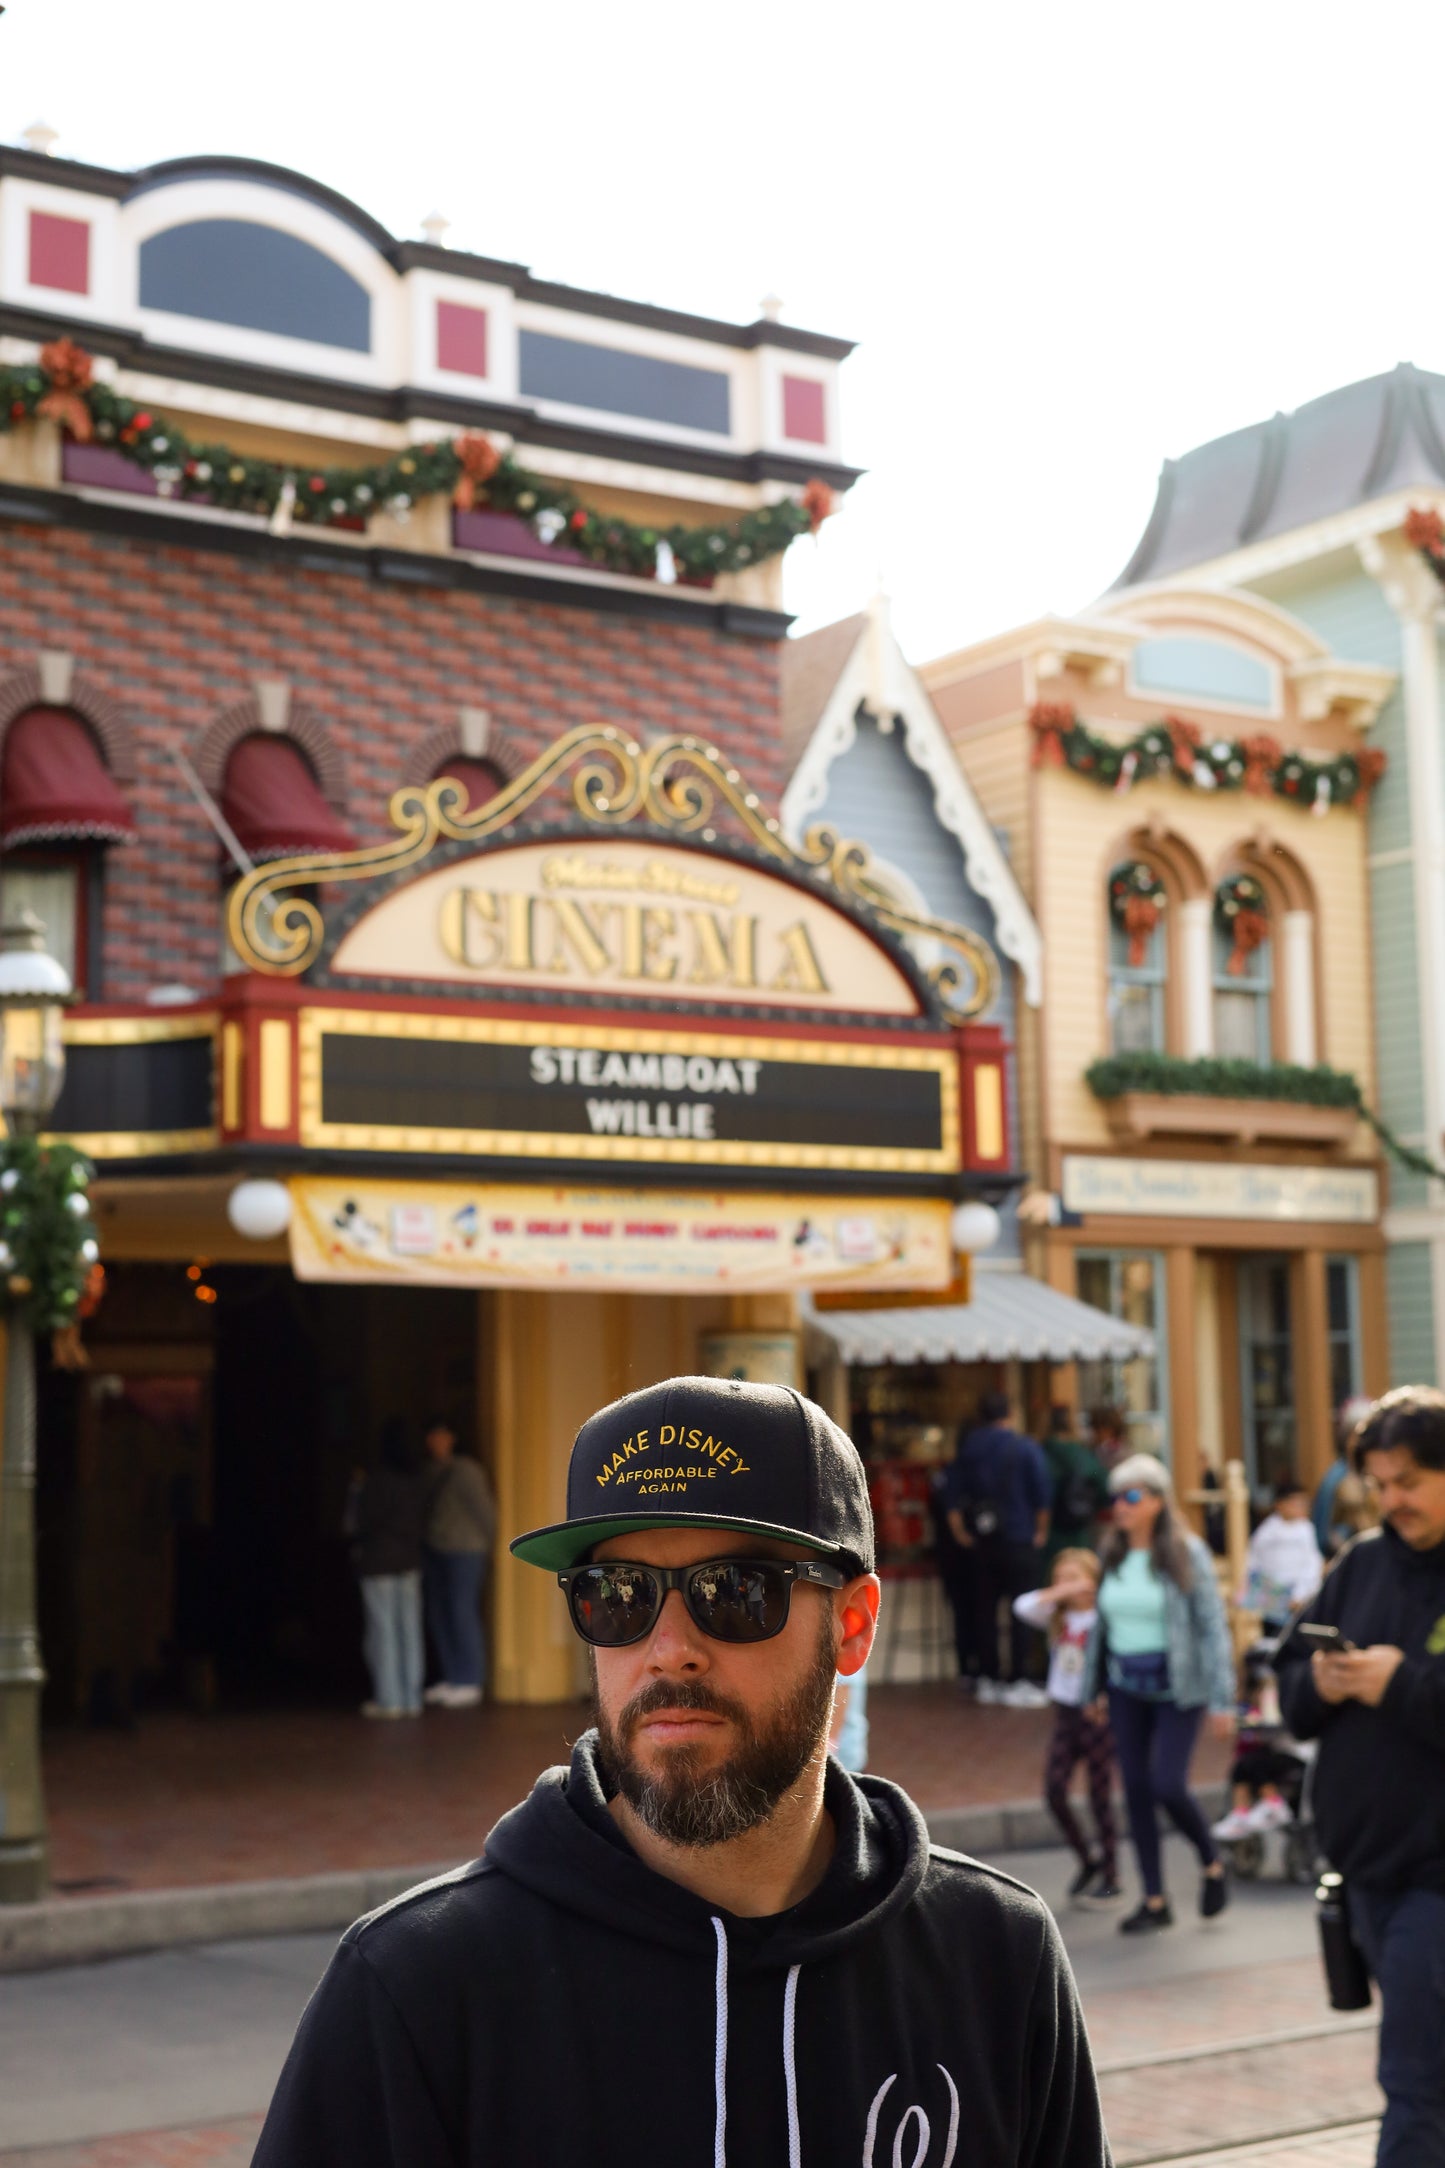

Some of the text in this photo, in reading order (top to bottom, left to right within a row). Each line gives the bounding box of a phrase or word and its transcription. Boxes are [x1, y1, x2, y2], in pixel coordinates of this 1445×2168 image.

[438, 885, 830, 993] CINEMA
[529, 1044, 762, 1095] STEAMBOAT
[585, 1097, 716, 1140] WILLIE
[595, 1424, 751, 1487] MAKE DISNEY
[615, 1466, 718, 1486] AFFORDABLE
[637, 1482, 688, 1496] AGAIN
